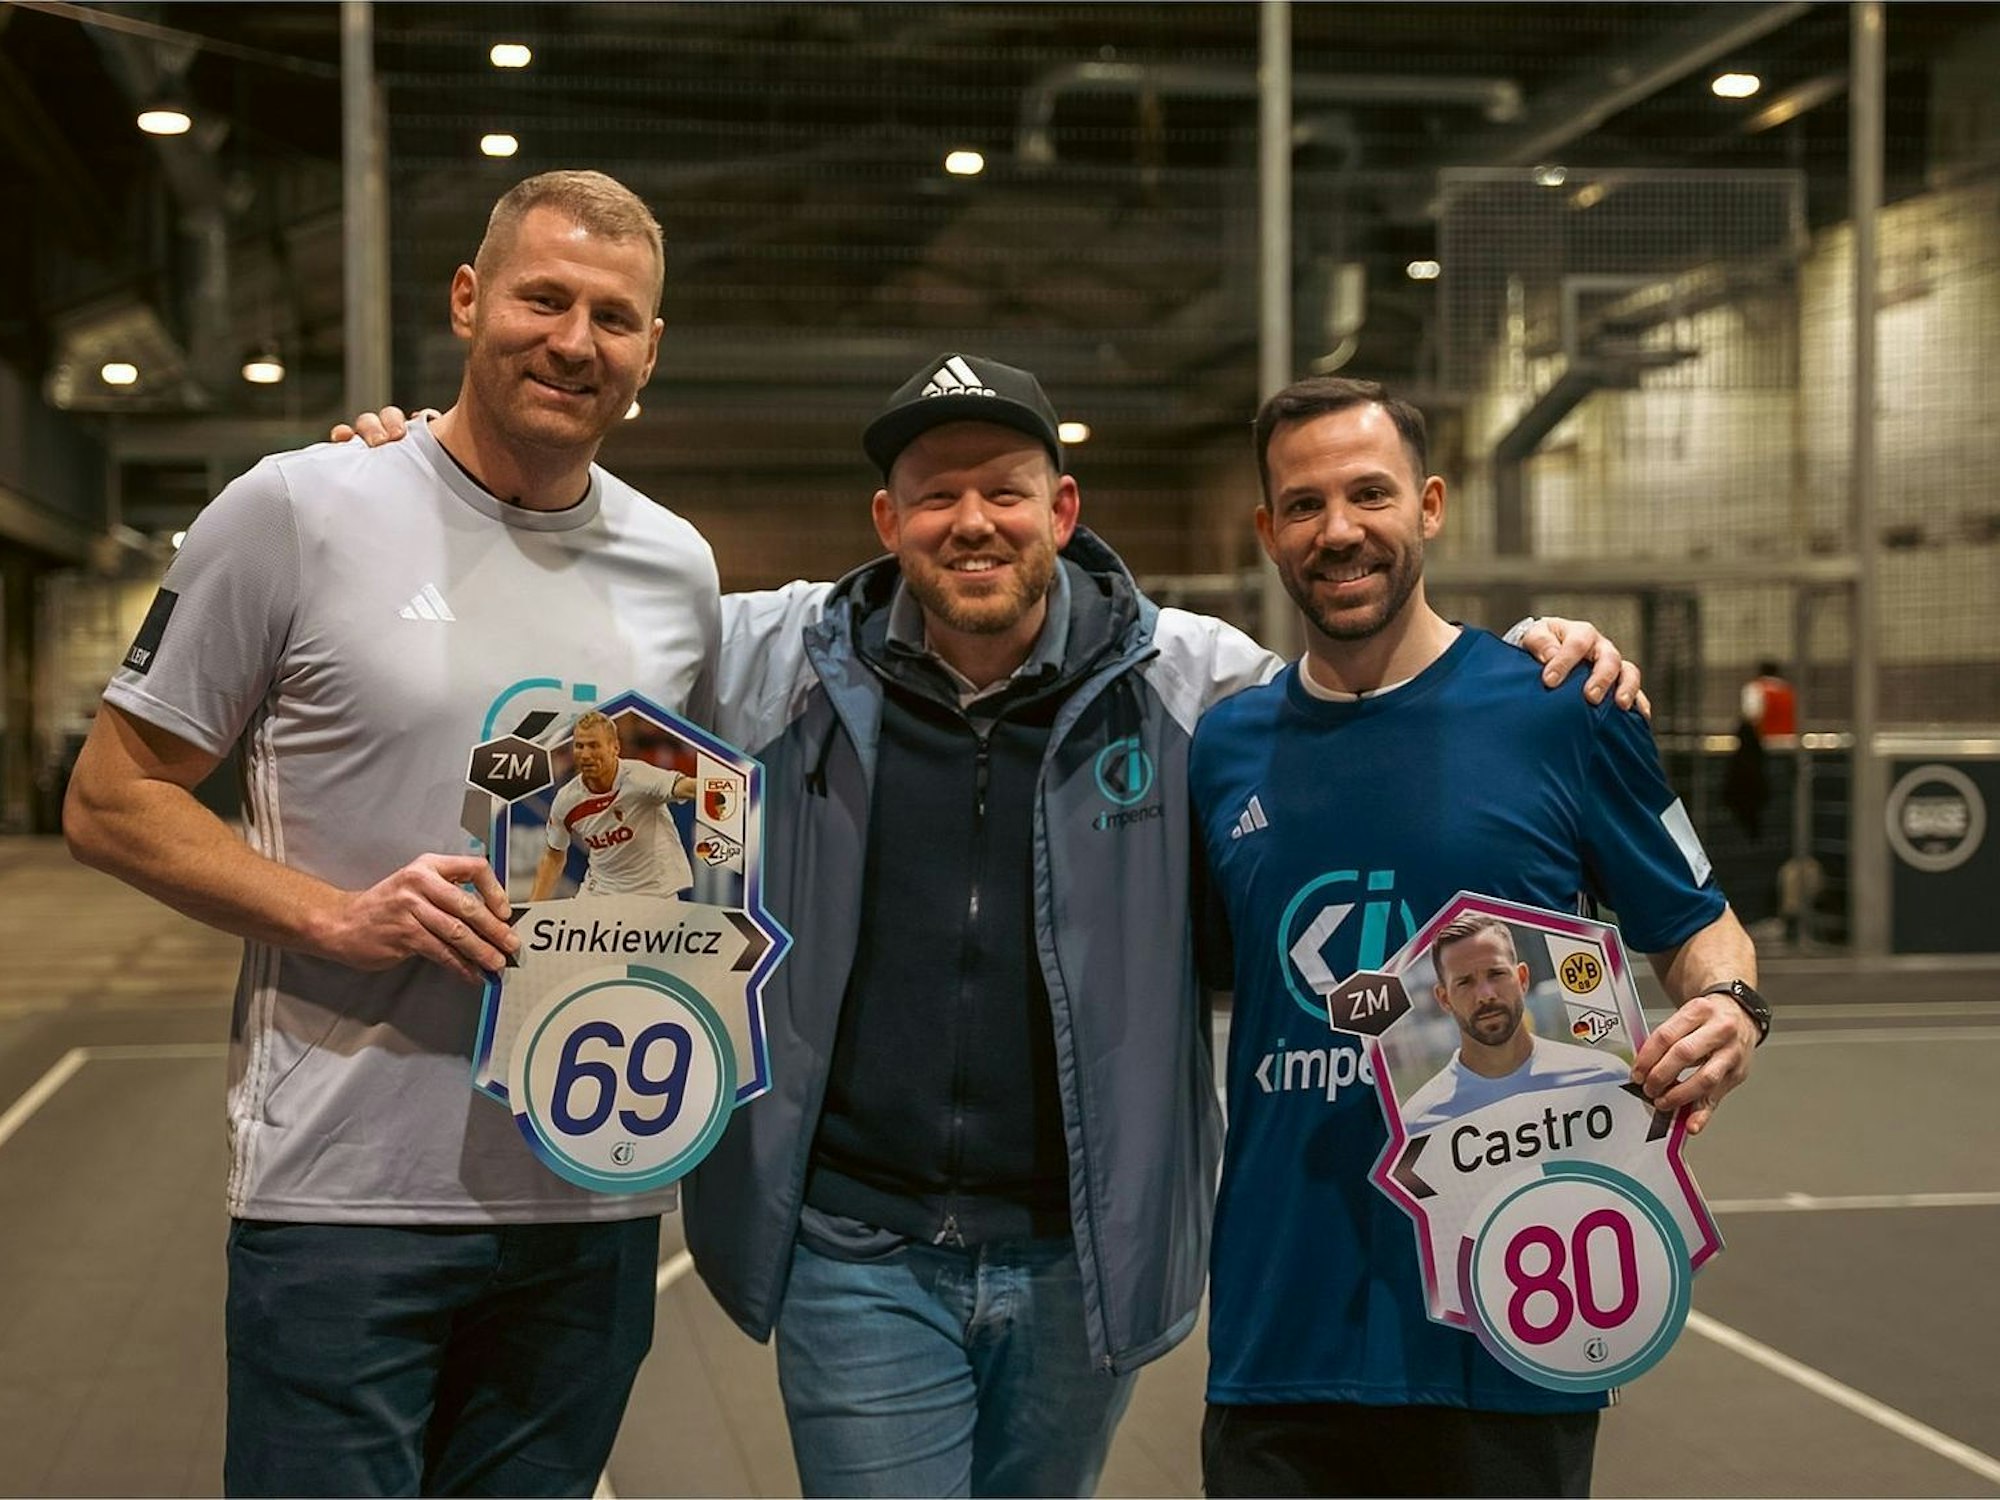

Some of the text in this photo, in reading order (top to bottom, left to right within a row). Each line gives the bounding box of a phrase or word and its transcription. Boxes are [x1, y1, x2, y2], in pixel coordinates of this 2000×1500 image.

[487, 753, 534, 780] ZM
[529, 919, 722, 955] Sinkiewicz
[1565, 956, 1597, 984] BVB
[1347, 984, 1390, 1021] ZM
[550, 1021, 693, 1137] 69
[1451, 1104, 1613, 1173] Castro
[1504, 1208, 1640, 1345] 80
